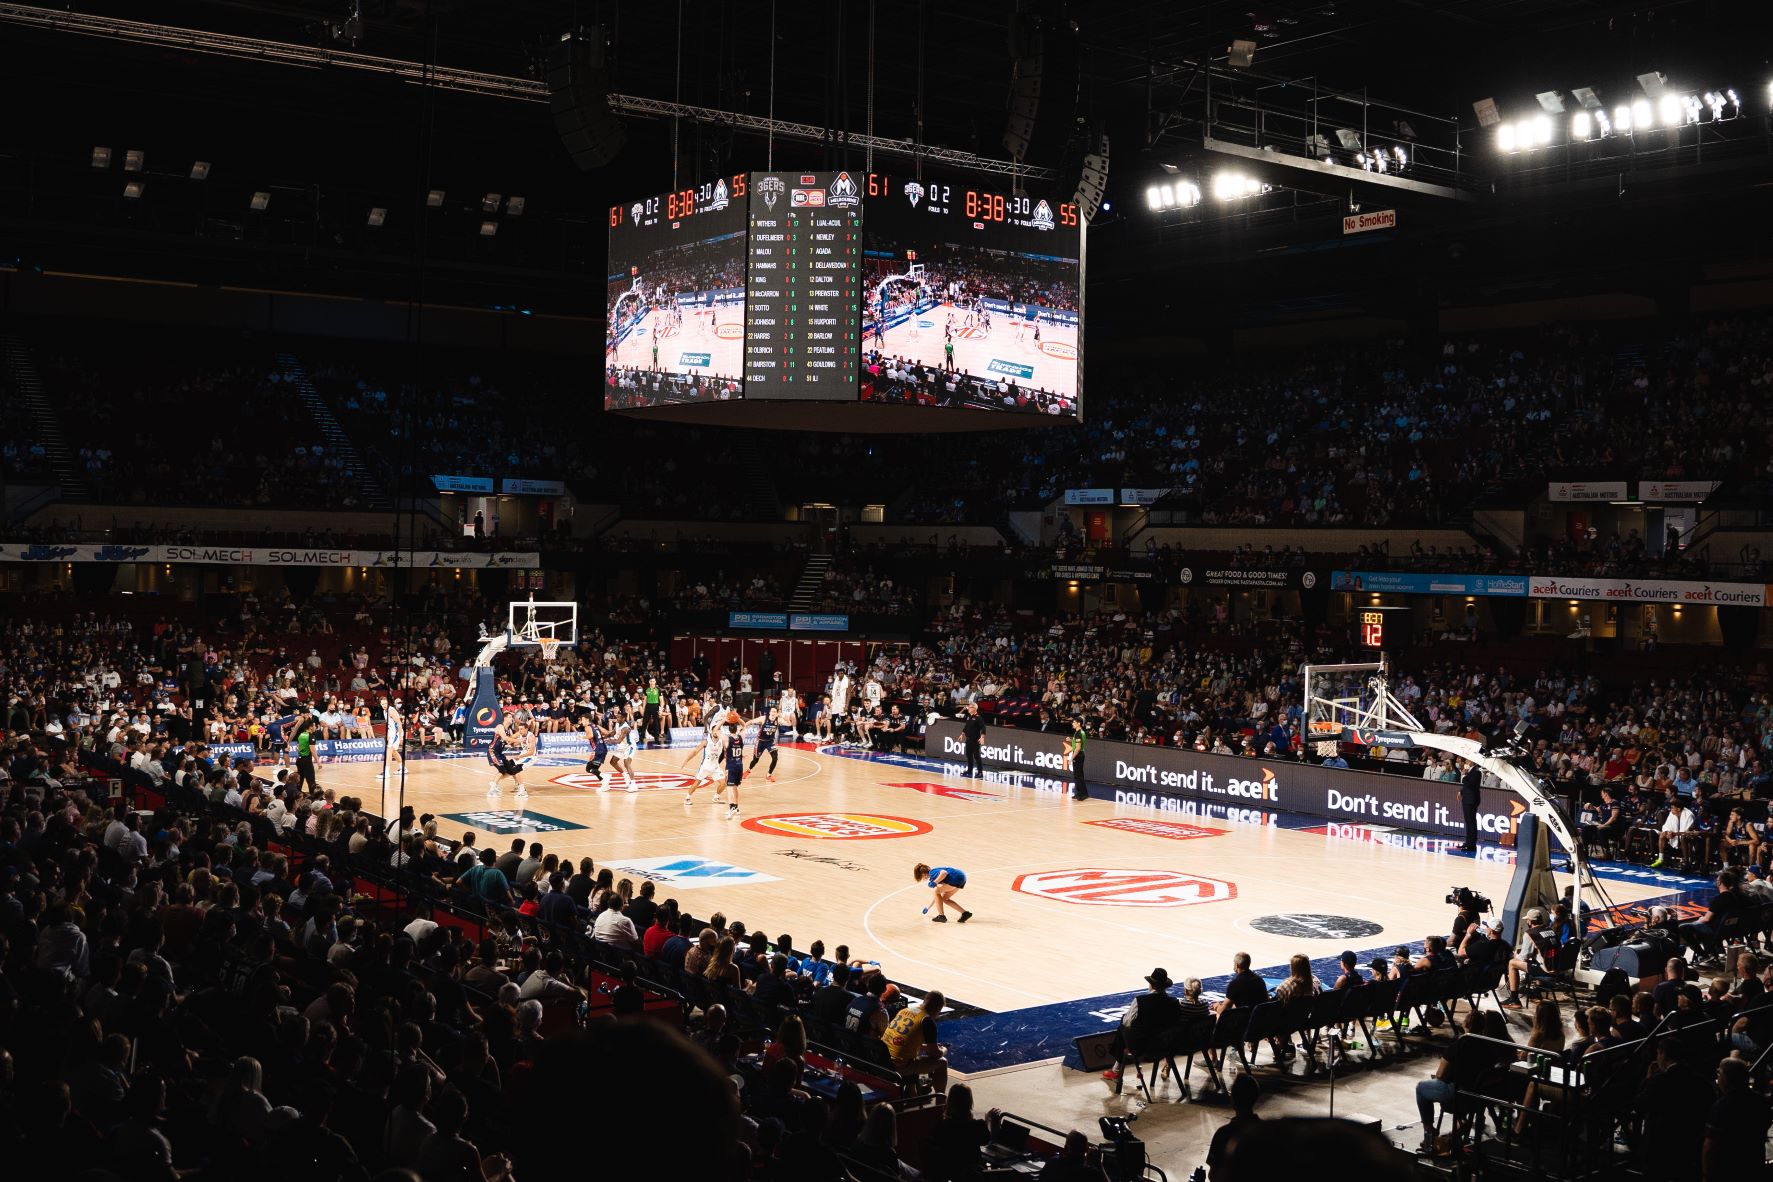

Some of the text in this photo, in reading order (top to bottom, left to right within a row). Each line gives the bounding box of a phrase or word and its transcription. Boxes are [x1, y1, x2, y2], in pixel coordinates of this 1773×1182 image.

[733, 174, 745, 197] 55
[758, 182, 784, 192] 36ERS
[869, 174, 888, 196] 61
[904, 184, 924, 197] 36ERS
[668, 190, 694, 220] 8:38
[966, 191, 1004, 222] 8:38
[611, 206, 622, 226] 61
[1060, 204, 1076, 226] 55
[1345, 213, 1394, 230] No Smoking
[166, 548, 252, 561] SOLMECH
[268, 551, 350, 564] SOLMECH
[1488, 579, 1524, 590] HomeStart
[1533, 584, 1557, 595] aceit
[1559, 585, 1599, 596] Couriers
[1606, 587, 1678, 599] aceit Couriers
[1684, 589, 1761, 603] aceit Couriers
[335, 740, 382, 750] Harcourts
[1375, 735, 1405, 744] Tyrepower
[732, 748, 742, 757] 10
[980, 744, 1010, 762] send
[1116, 760, 1278, 800] Don't send it... aceit
[112, 782, 119, 795] F
[1328, 789, 1378, 816] Don't
[1383, 801, 1428, 823] send
[1435, 803, 1464, 829] it...
[888, 1014, 914, 1034] 33
